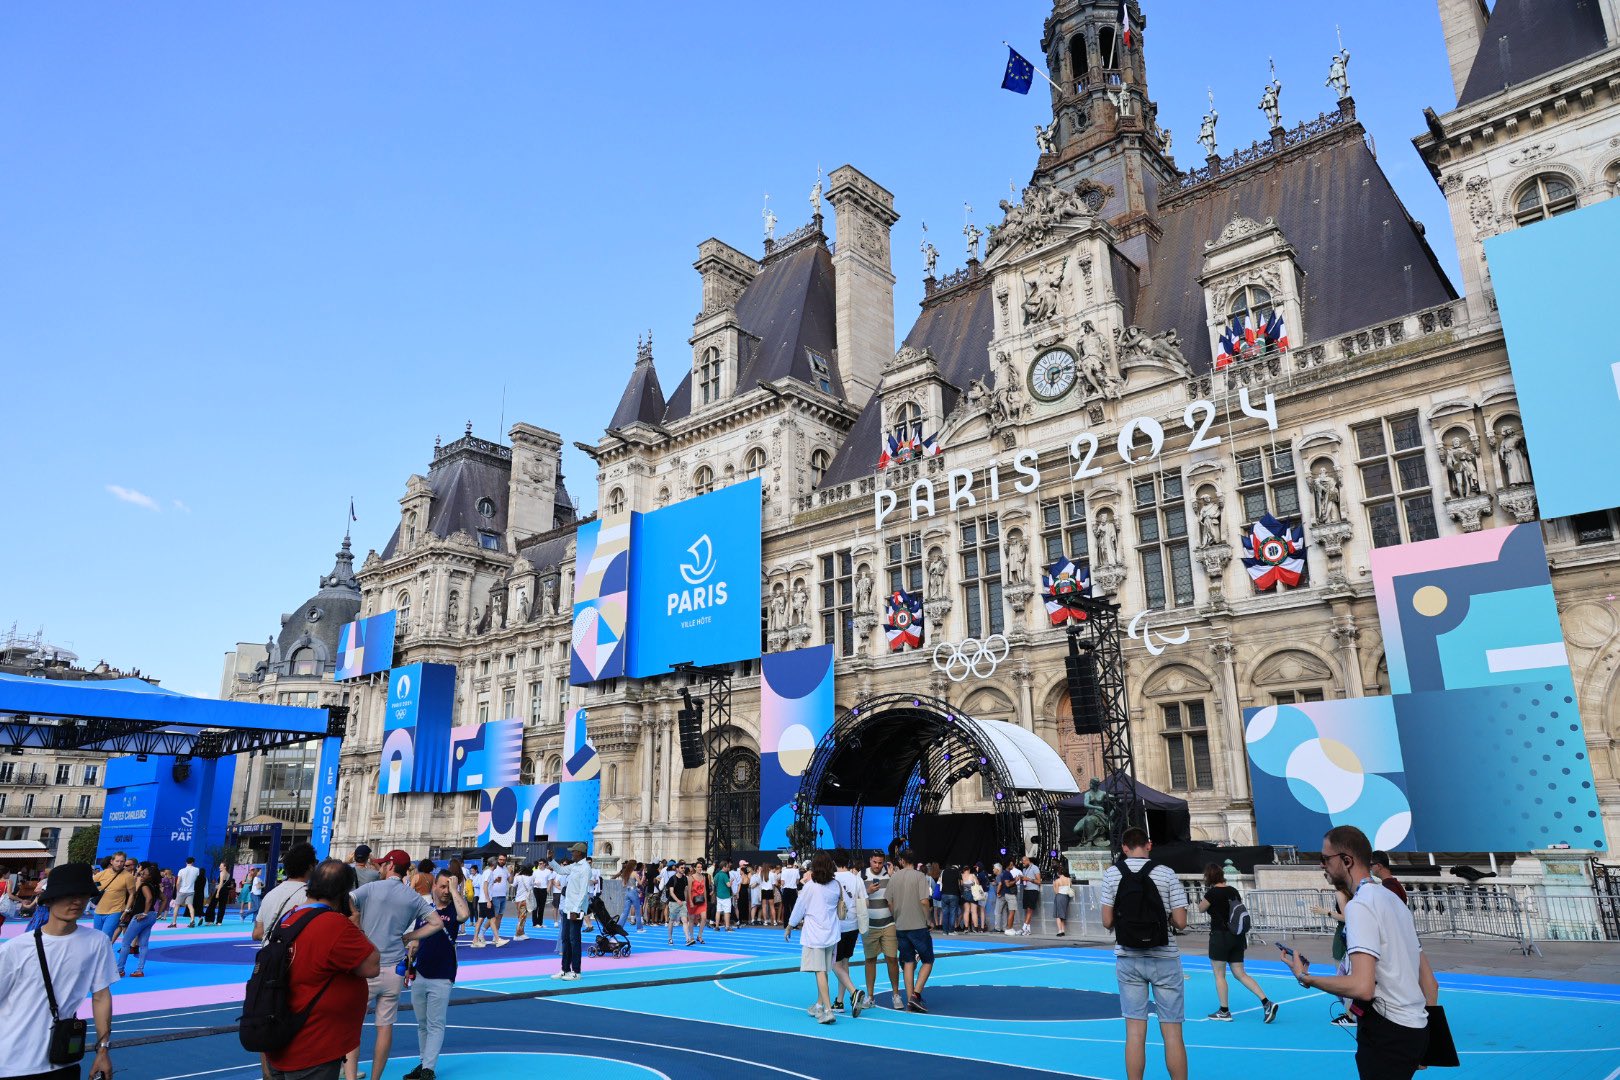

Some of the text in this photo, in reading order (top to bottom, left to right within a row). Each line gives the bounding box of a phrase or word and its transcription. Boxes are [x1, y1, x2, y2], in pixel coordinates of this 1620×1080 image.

[1071, 387, 1278, 481] 2024
[667, 581, 728, 616] PARIS
[681, 615, 712, 629] VILLE HÔTE
[321, 766, 334, 844] LE COURT
